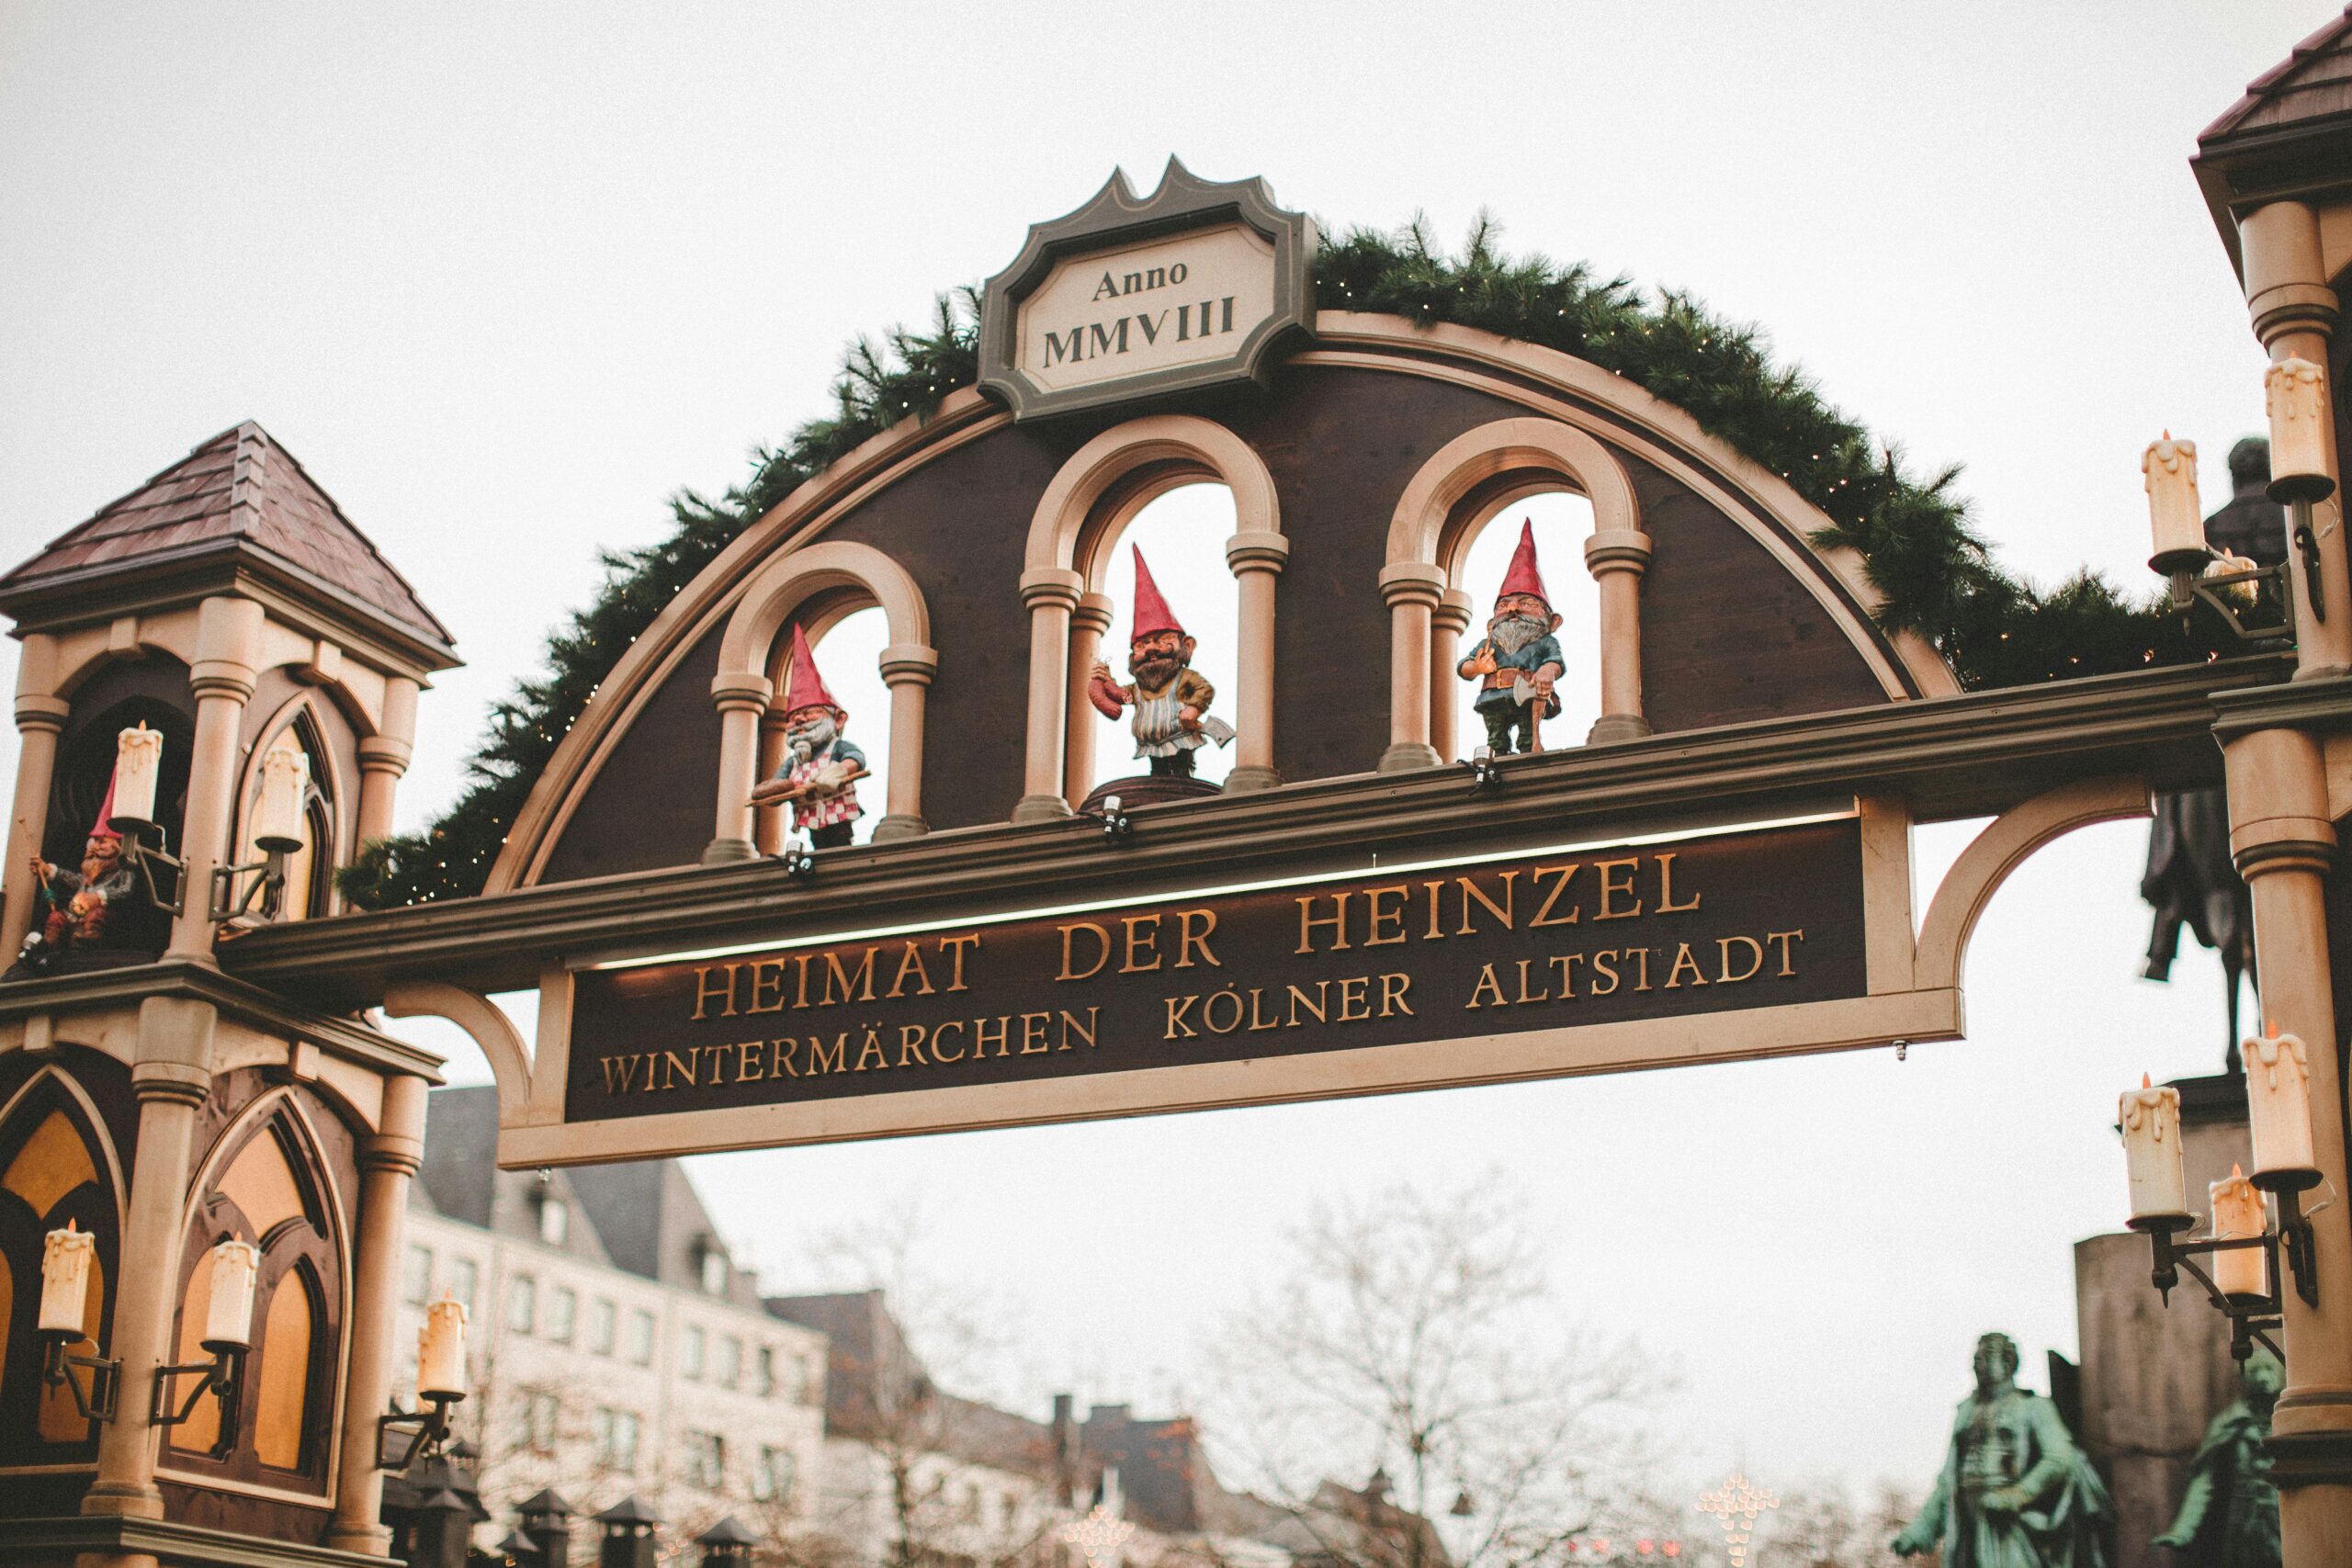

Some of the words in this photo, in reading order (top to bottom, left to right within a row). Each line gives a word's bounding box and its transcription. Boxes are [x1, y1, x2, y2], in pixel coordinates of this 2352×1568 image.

[1044, 297, 1235, 367] MMVIII
[1092, 263, 1187, 301] Anno
[690, 933, 980, 1020] HEIMAT
[1055, 908, 1221, 981] DER
[1294, 853, 1701, 953] HEINZEL
[600, 1007, 1100, 1093] WINTERMÄRCHEN
[1465, 929, 1804, 1009] ALTSTADT
